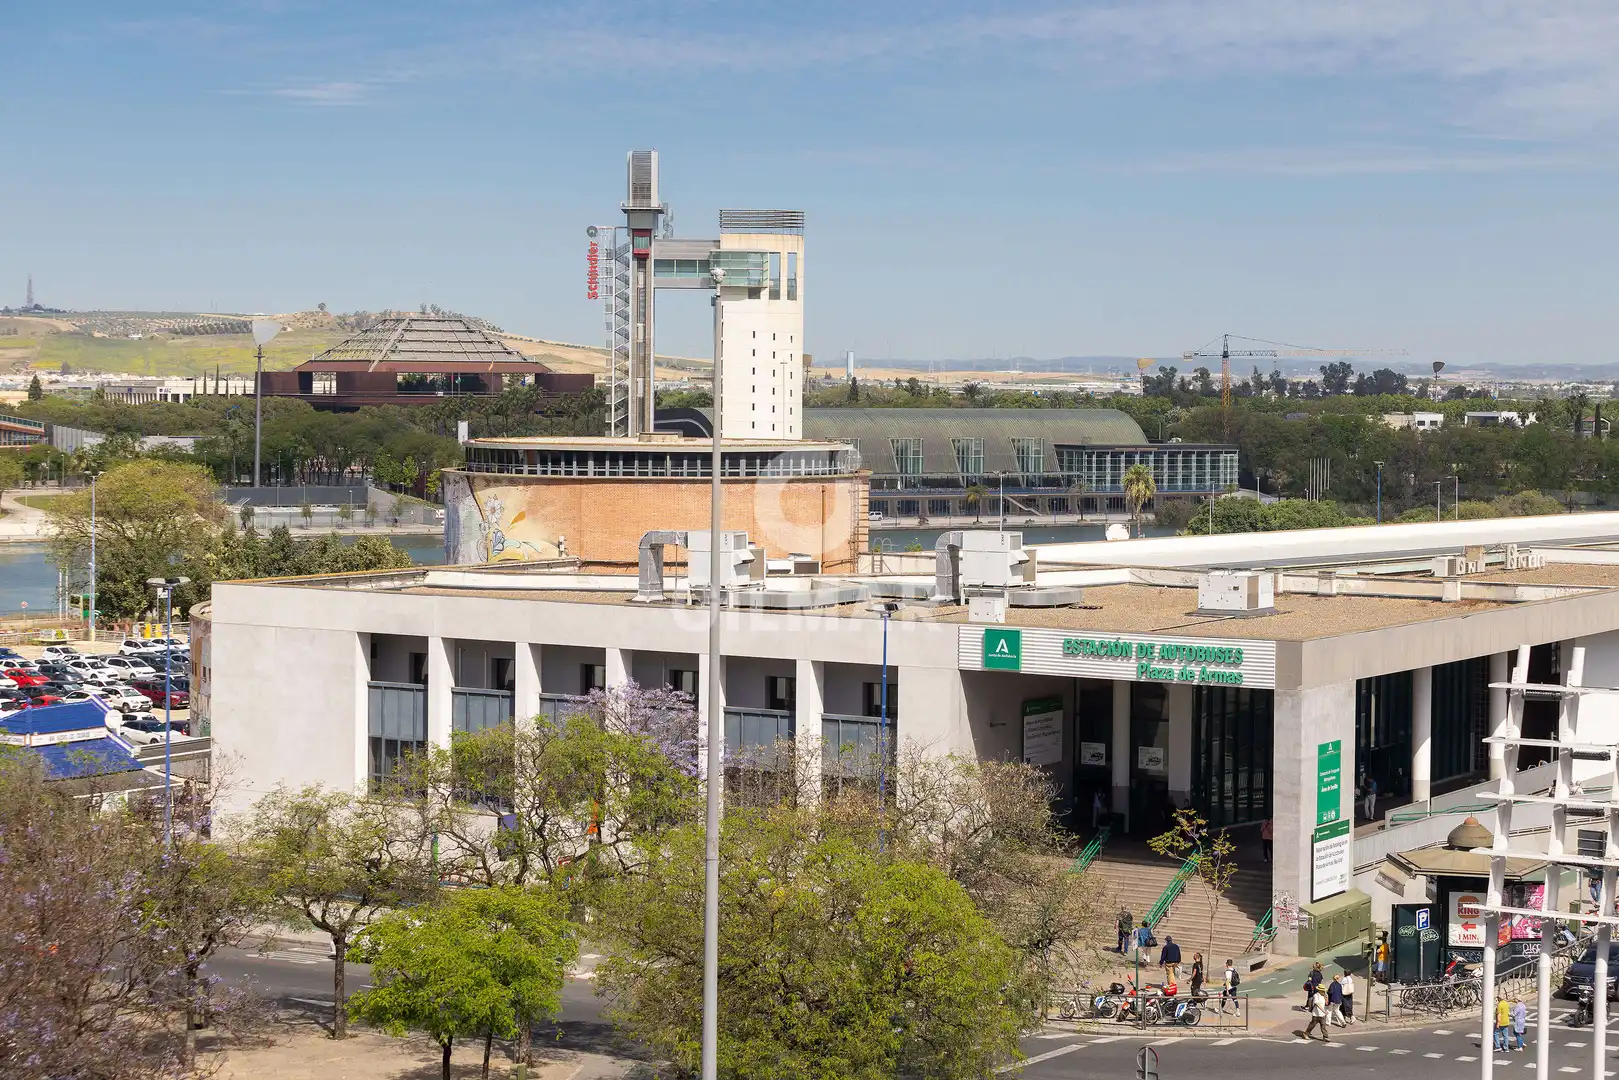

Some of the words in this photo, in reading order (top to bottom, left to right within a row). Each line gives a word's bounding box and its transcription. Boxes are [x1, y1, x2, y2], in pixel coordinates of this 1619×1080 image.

[587, 241, 599, 299] Schindler
[1063, 637, 1133, 658] ESTACIÓN
[1137, 643, 1156, 659] DE
[1159, 644, 1244, 664] AUTOBUSES
[1137, 663, 1175, 680] Plaza
[1178, 666, 1195, 681] de
[1199, 666, 1244, 685] Armas
[1457, 907, 1480, 915] KING
